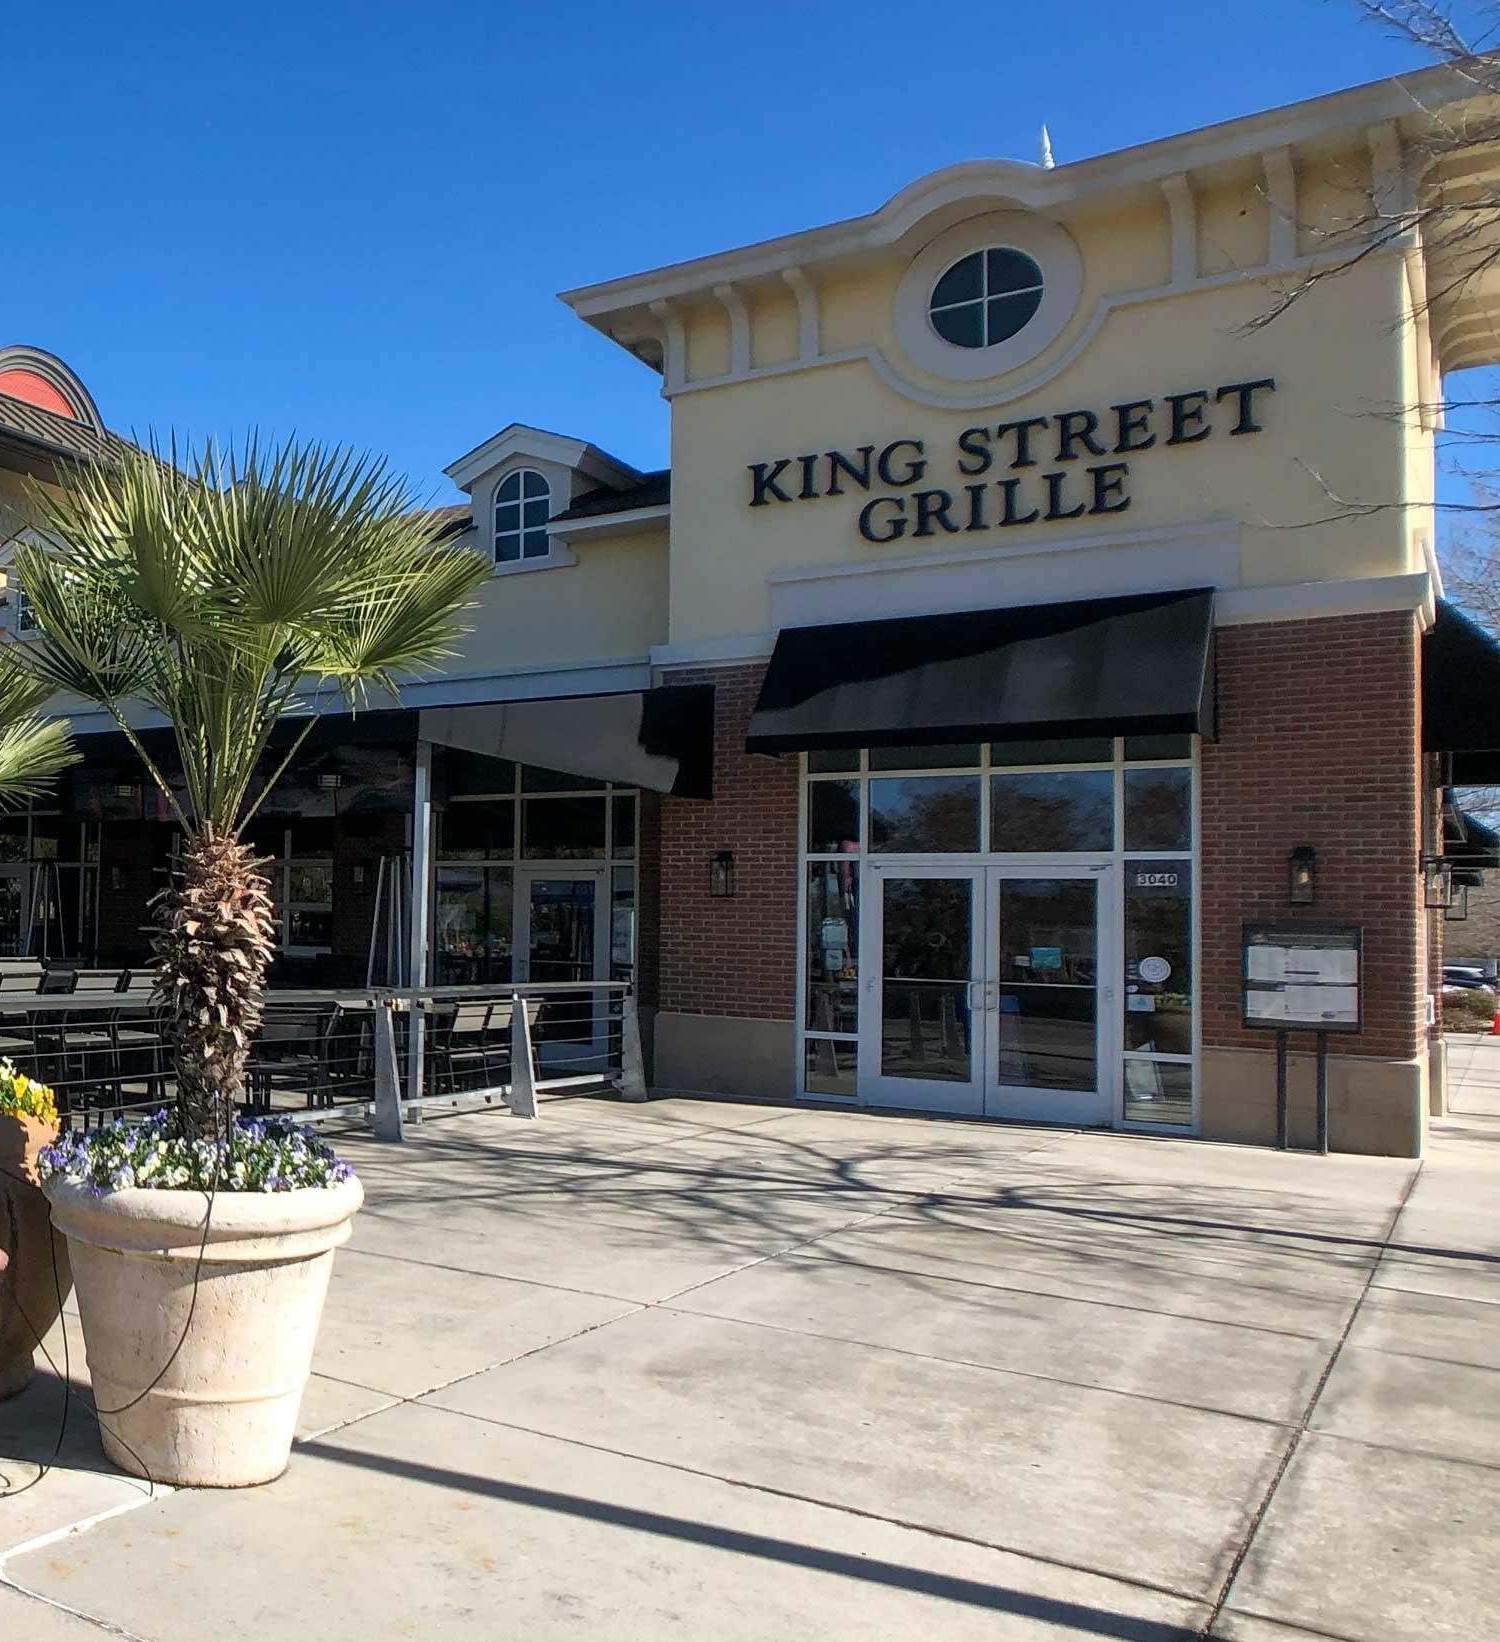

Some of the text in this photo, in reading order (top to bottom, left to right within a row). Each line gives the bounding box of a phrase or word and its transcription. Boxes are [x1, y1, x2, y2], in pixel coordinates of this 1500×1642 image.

[747, 377, 1277, 507] KING STREET
[858, 462, 1132, 544] GRILLE
[1138, 874, 1177, 886] 3040
